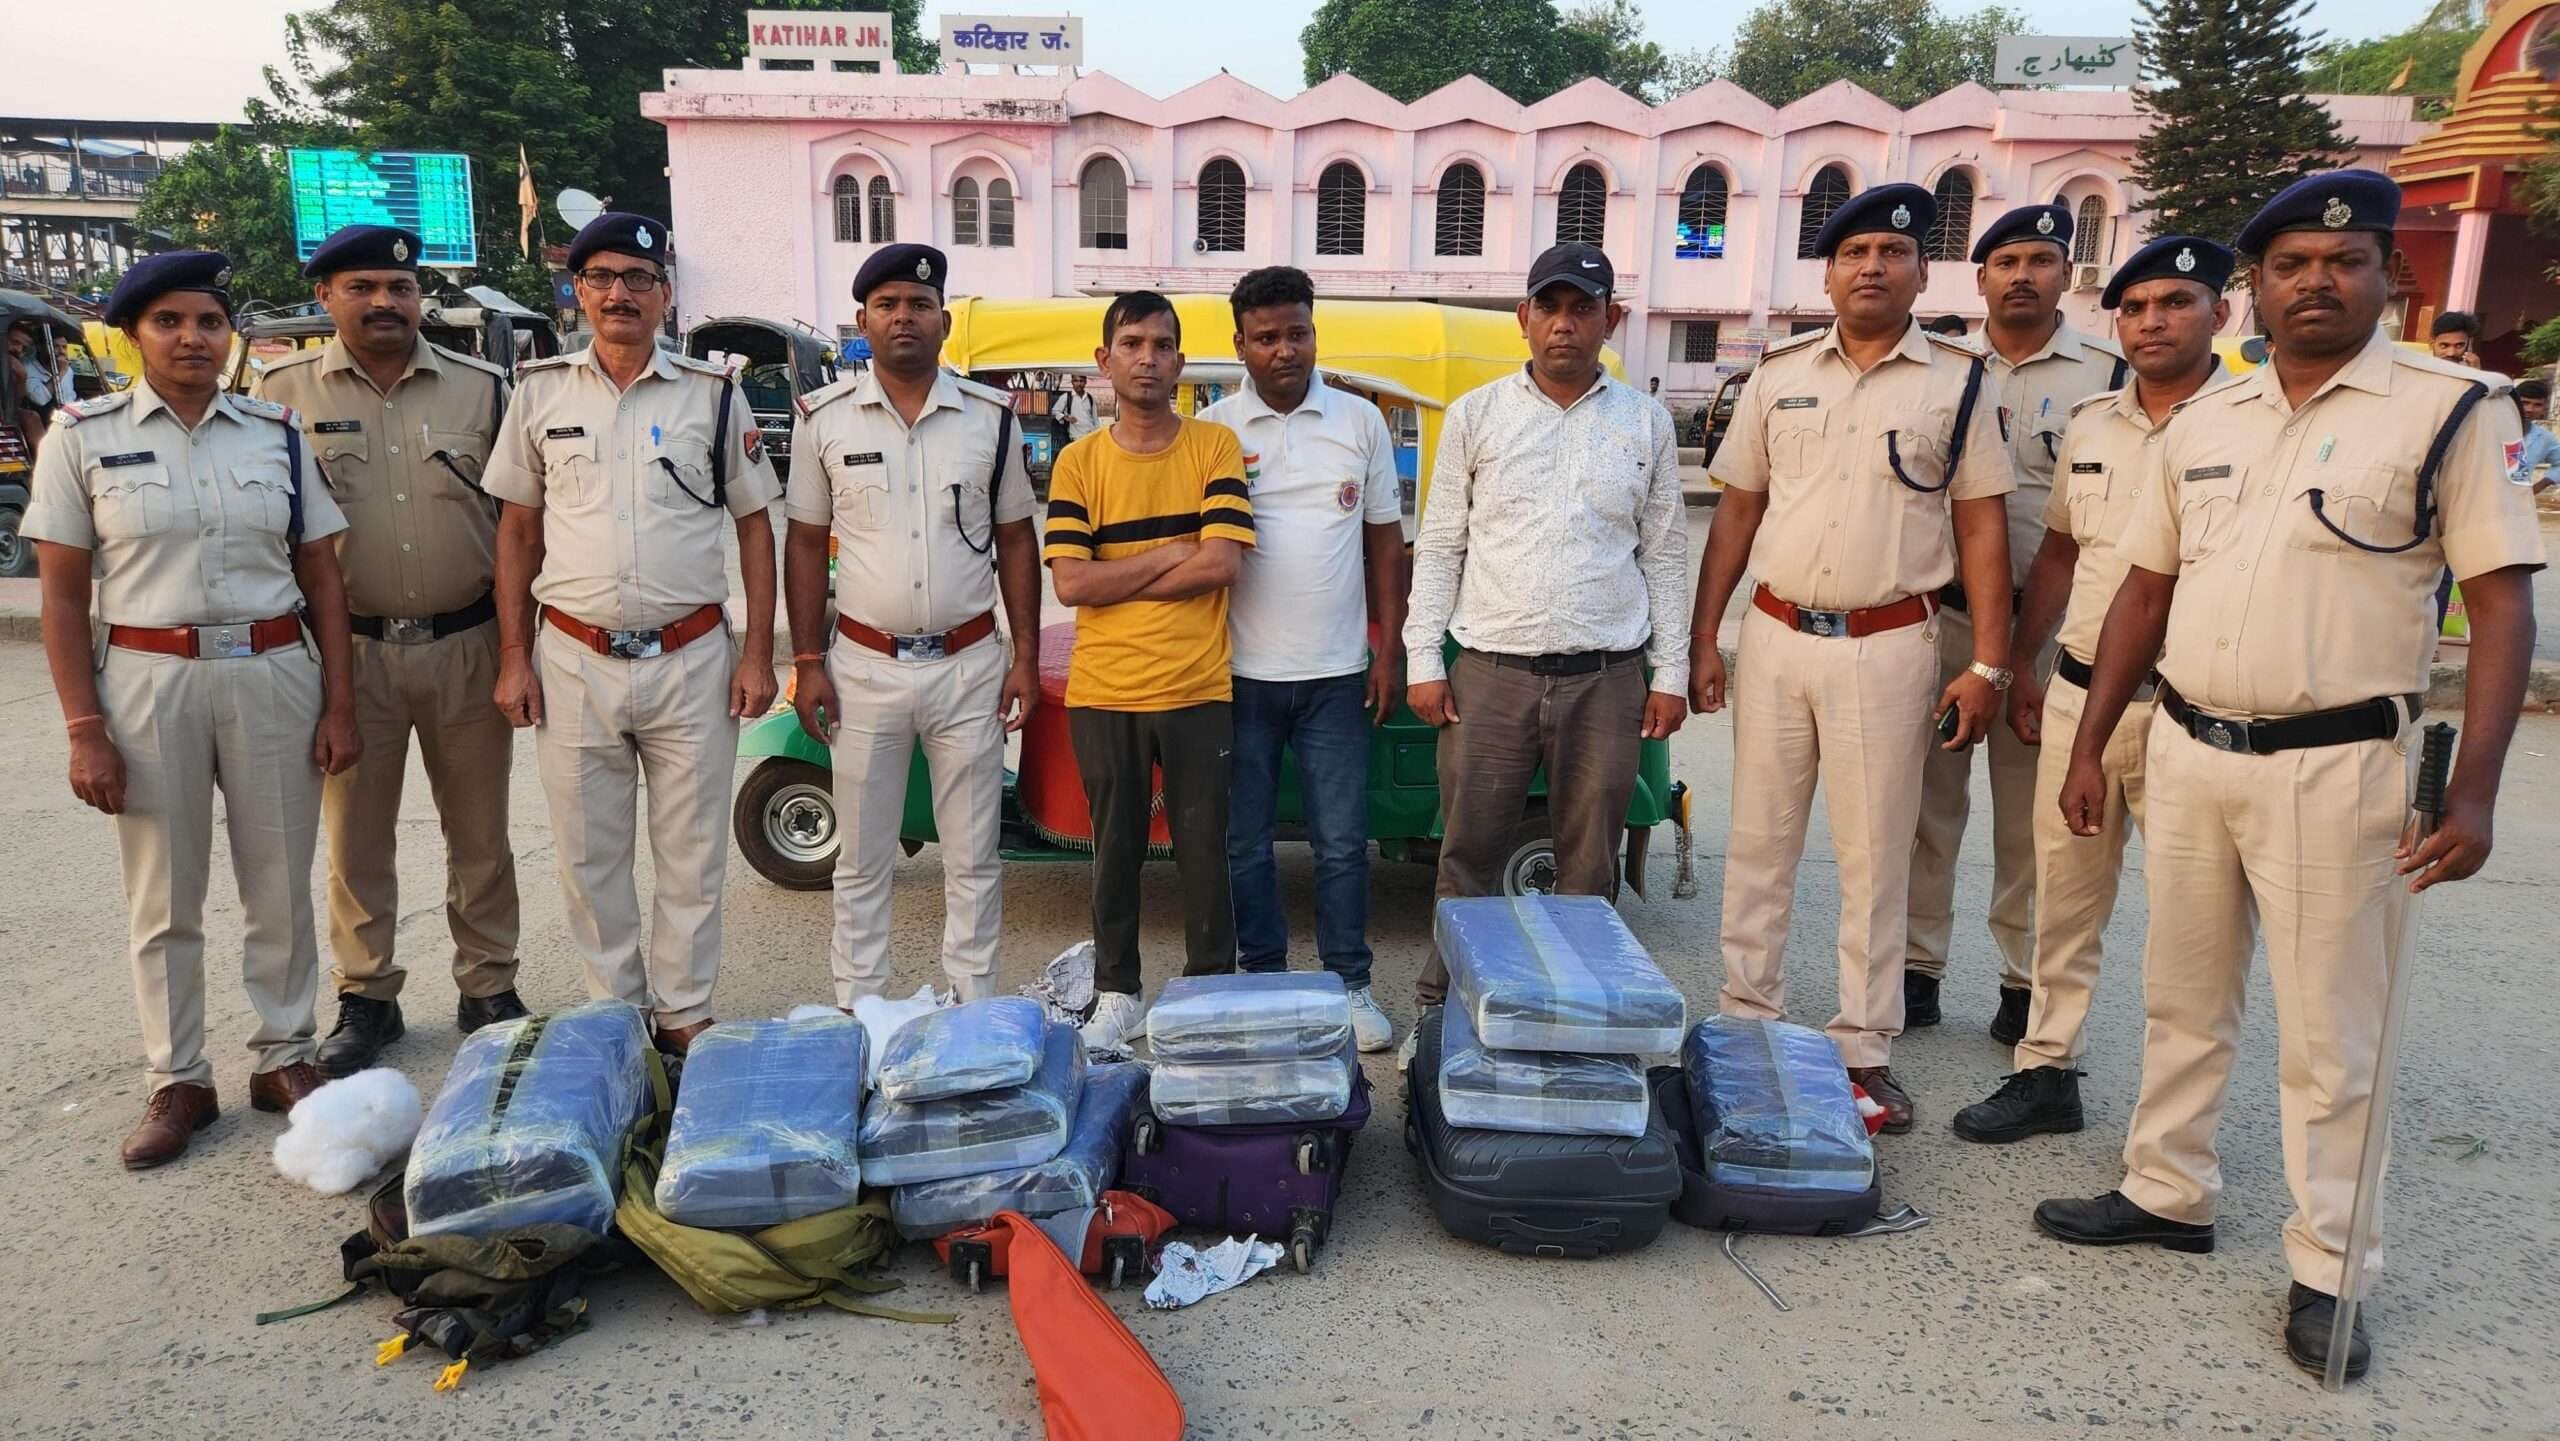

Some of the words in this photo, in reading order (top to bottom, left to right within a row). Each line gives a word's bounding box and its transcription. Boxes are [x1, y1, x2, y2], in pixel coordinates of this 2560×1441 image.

[752, 24, 848, 47] KATIHAR
[855, 26, 888, 48] JN.
[953, 23, 1029, 52] कटिहार
